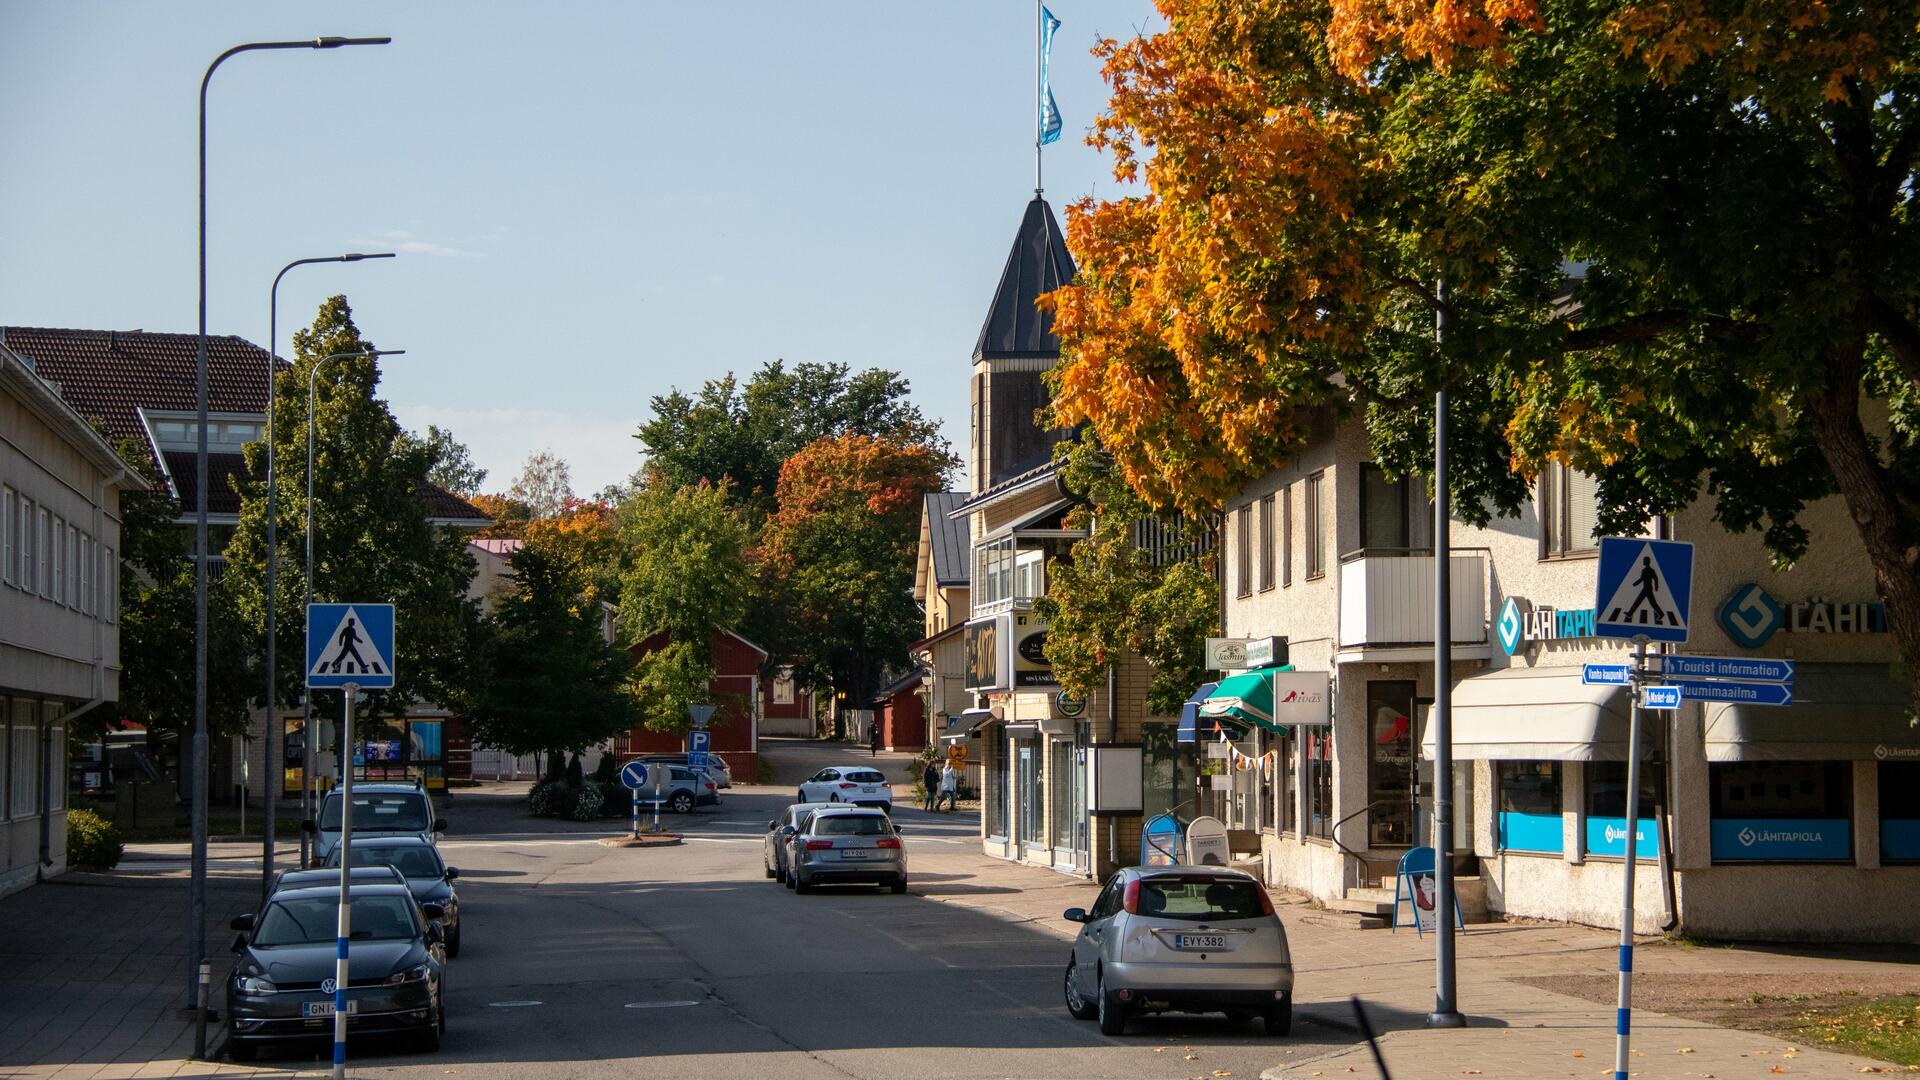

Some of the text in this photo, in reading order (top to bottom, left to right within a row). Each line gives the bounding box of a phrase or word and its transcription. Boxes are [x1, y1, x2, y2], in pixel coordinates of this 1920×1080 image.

[1677, 660, 1779, 676] Tourist information
[693, 733, 707, 750] P
[1758, 829, 1823, 842] LÄHITAPIOLA
[1183, 936, 1224, 947] EVY-382
